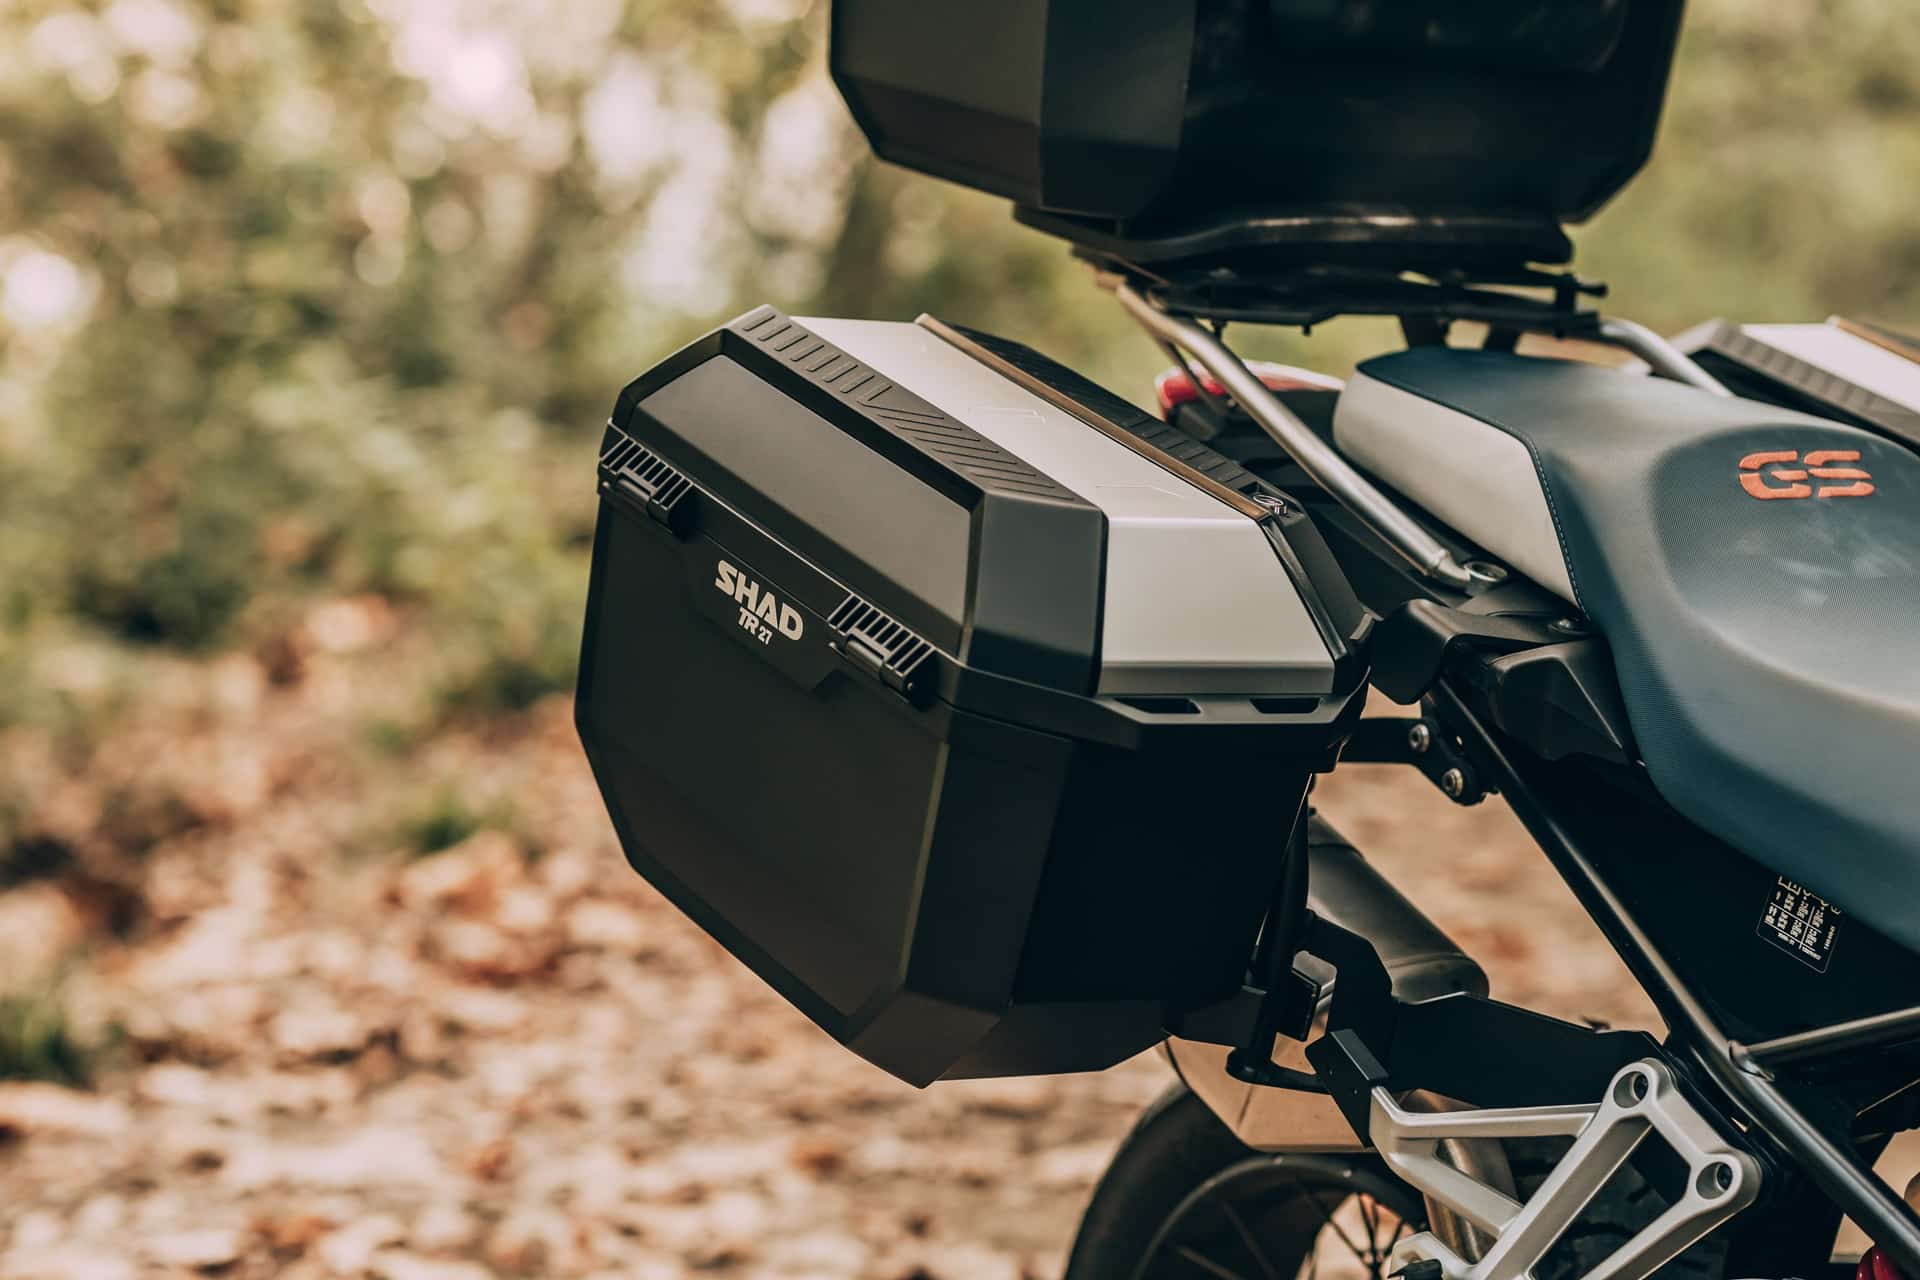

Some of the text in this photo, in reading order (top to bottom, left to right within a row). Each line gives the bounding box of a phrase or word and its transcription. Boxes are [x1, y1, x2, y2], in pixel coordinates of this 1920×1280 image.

[1739, 450, 1875, 500] GS
[715, 559, 804, 641] SHAD
[738, 606, 773, 645] TR 27
